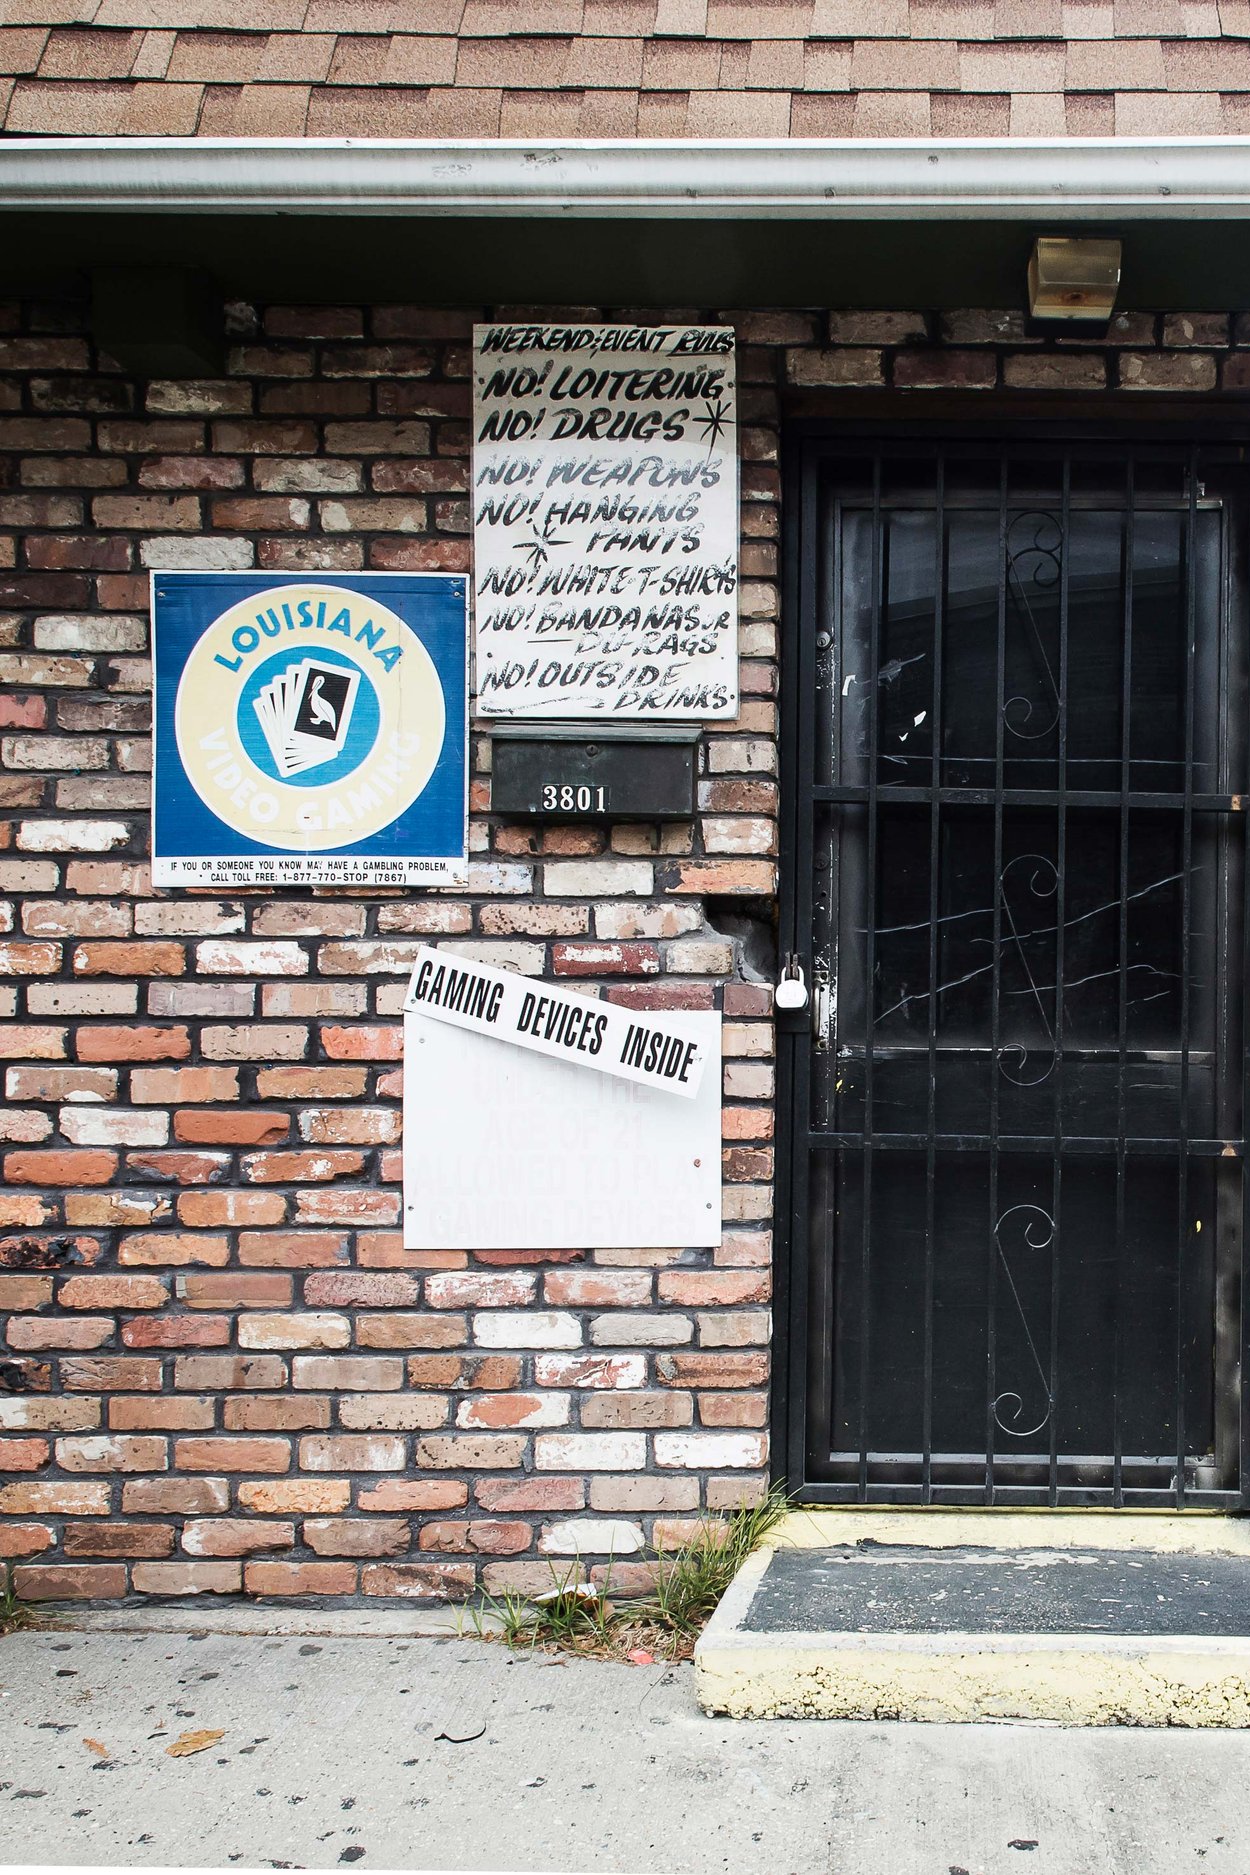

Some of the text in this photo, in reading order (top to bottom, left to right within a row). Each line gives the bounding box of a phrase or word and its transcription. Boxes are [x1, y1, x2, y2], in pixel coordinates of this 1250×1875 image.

[480, 326, 594, 355] WEEKEND
[600, 328, 676, 354] EVENT
[482, 360, 726, 401] NO! LOITERING
[478, 408, 690, 443] NO! DRUGS
[476, 455, 722, 489] NO! WEAPONS
[476, 492, 702, 526] NO! HANGING
[586, 523, 705, 555] PANTS
[478, 565, 541, 597] NO!
[537, 564, 634, 596] WHITE
[479, 603, 537, 633] NO!
[534, 601, 700, 634] BANDANAS
[213, 600, 405, 673] LOUISIANA
[479, 659, 691, 696] NO! OUTSIDE
[612, 683, 728, 712] DRINKS
[199, 726, 421, 831] VIDEO GAMING
[543, 785, 606, 813] 3801
[171, 861, 449, 872] IF YOU OR SOMEONE YOU KNOW MAY HAVE A GAMBLING PROBLEM,
[210, 873, 407, 883] CALL TOLL FREE: 1-877-770-STOP (7867)
[414, 960, 505, 1023] GAMING
[516, 992, 608, 1056] DEVICES
[619, 1024, 699, 1083] INSIDE
